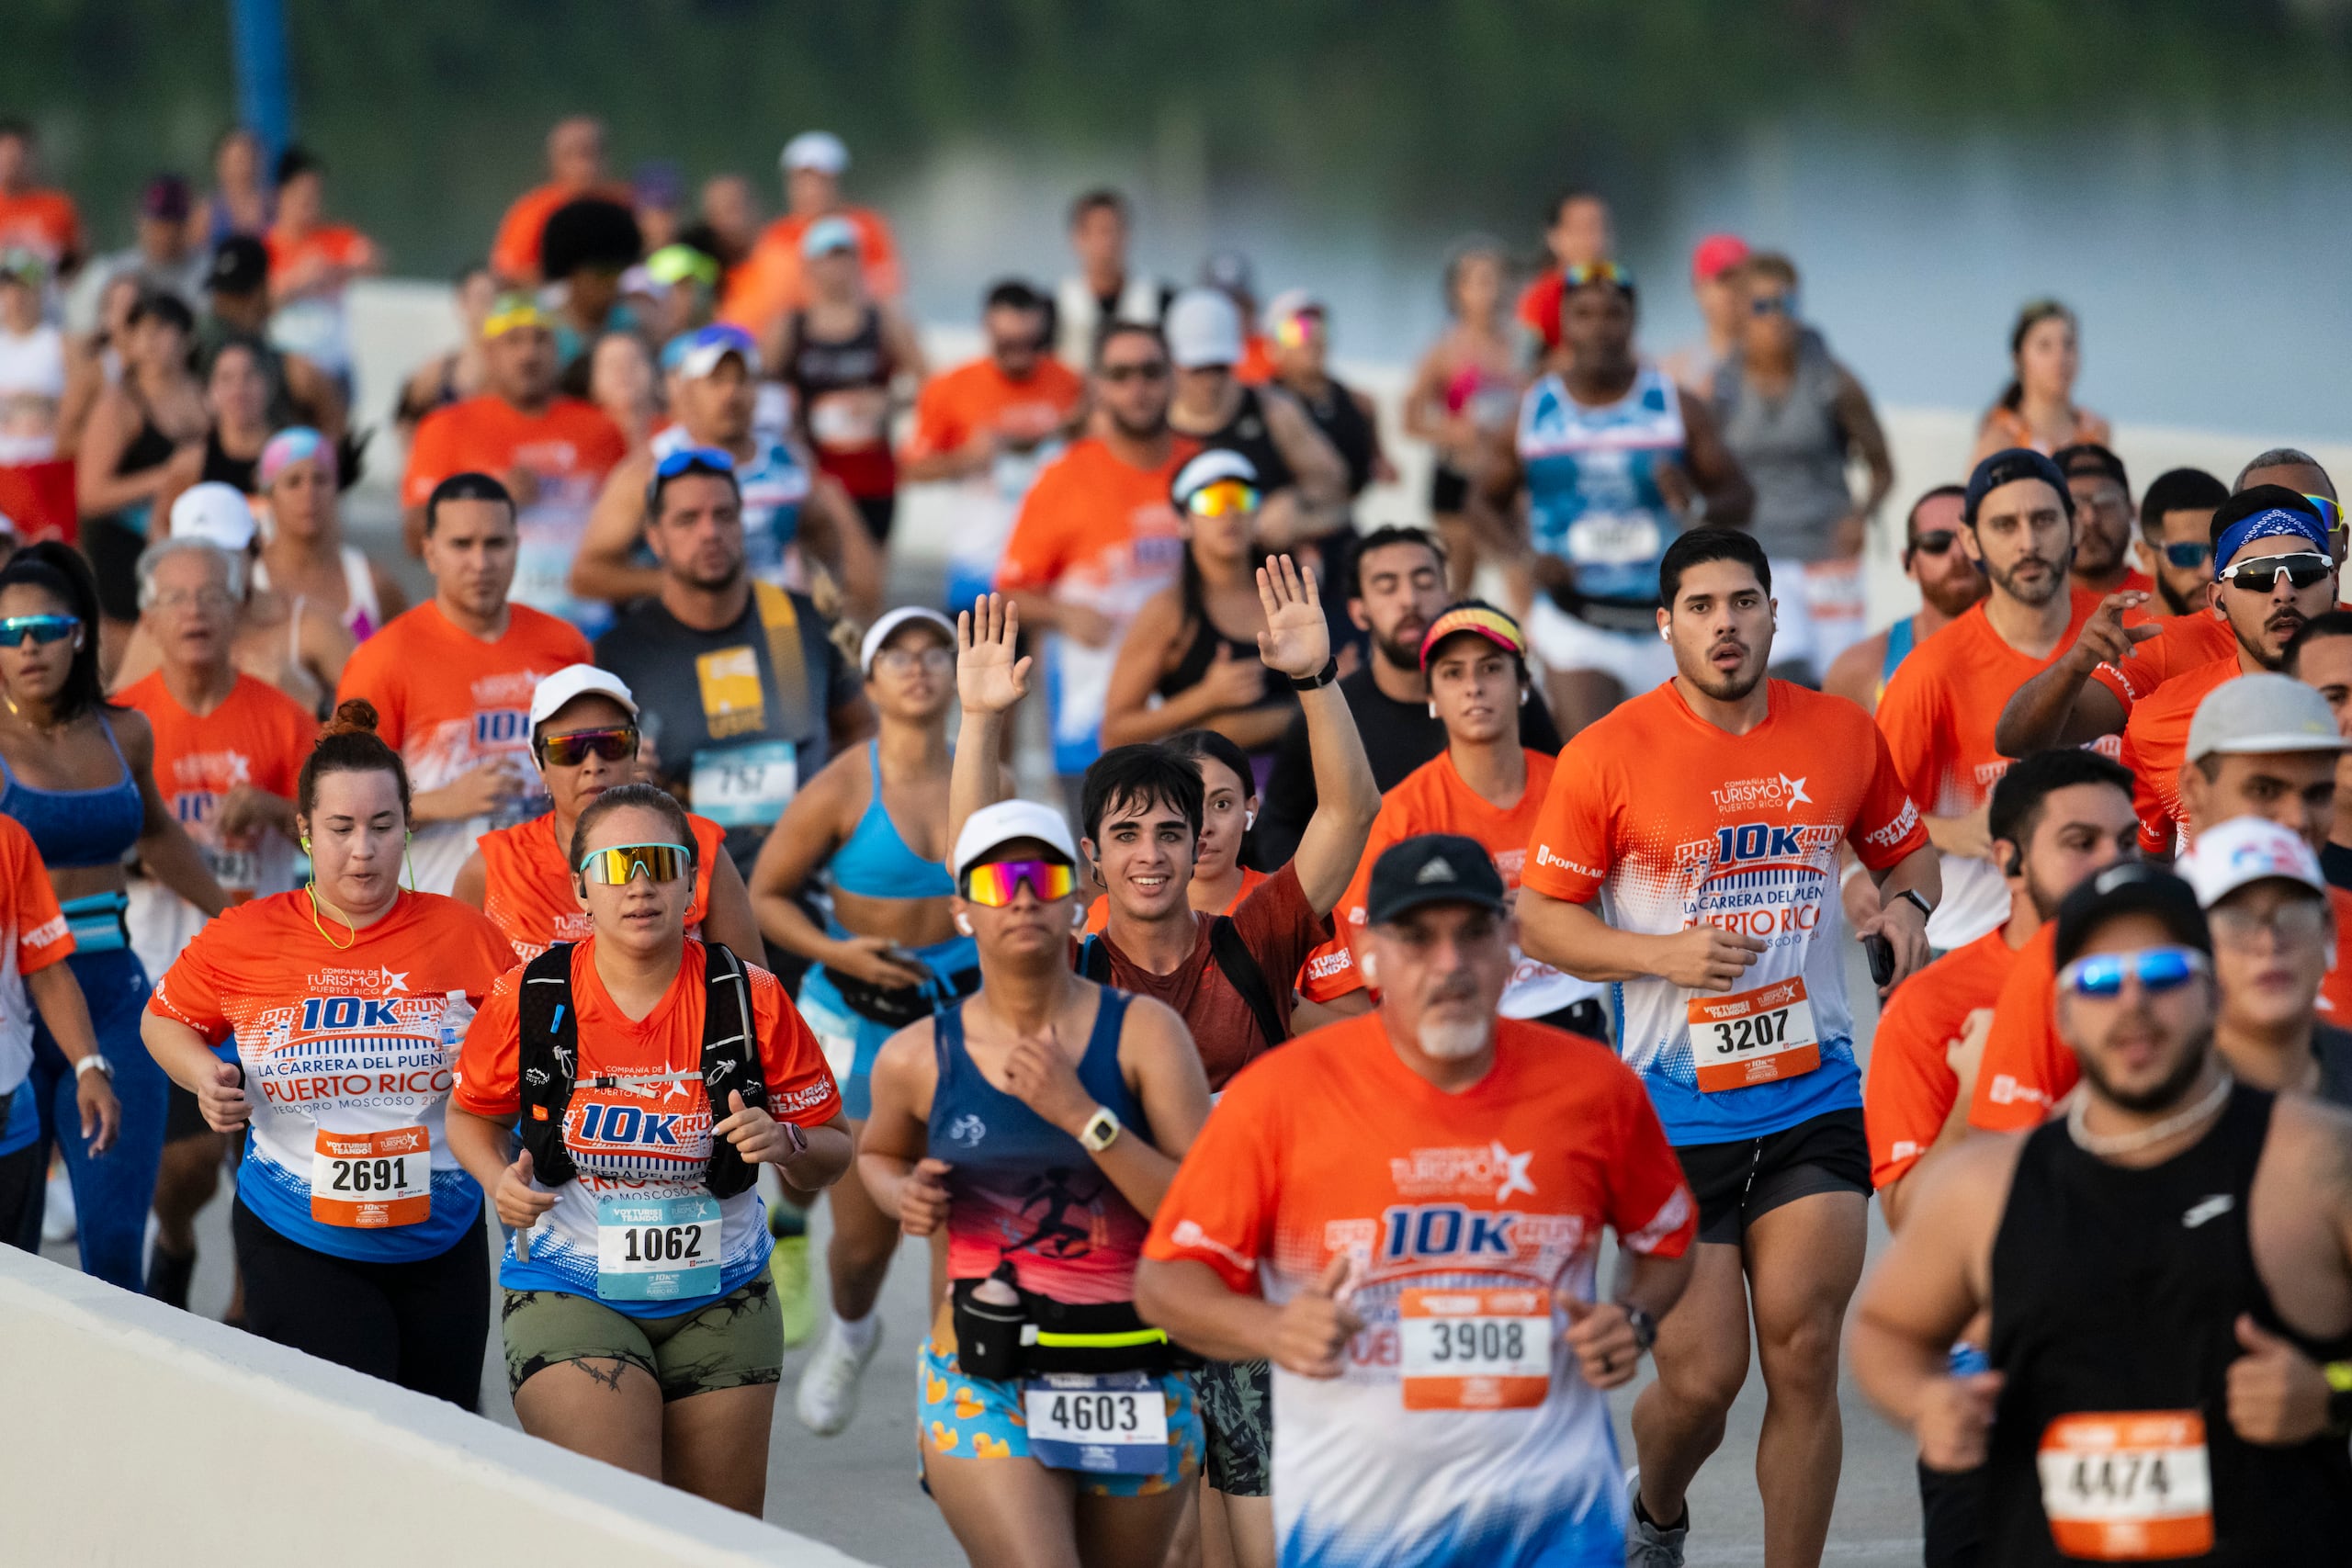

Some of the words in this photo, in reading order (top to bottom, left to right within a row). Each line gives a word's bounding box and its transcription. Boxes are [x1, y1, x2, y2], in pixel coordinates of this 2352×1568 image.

[1711, 784, 1781, 806] TURISMO
[1718, 802, 1756, 814] PUERTO
[1758, 798, 1784, 808] RICO
[1676, 840, 1710, 863] PR
[1717, 822, 1807, 864] 10K
[1547, 853, 1603, 878] POPULAR
[1684, 901, 1697, 914] LA
[1700, 893, 1763, 909] CARRERA
[1768, 891, 1791, 904] DEL
[1793, 886, 1825, 900] PUEN
[553, 916, 594, 931] TURIS
[306, 973, 379, 987] TURISMO
[311, 986, 349, 994] PUERTO
[262, 1008, 295, 1025] PR
[301, 997, 401, 1031] 10K
[400, 998, 447, 1014] RUN
[1713, 1008, 1789, 1054] 3207
[258, 1065, 274, 1077] LA
[277, 1058, 358, 1075] CARRERA
[363, 1056, 393, 1069] DEL
[651, 1066, 662, 1074] DE
[262, 1074, 372, 1102] PUERTO
[379, 1069, 454, 1093] RICO
[594, 1088, 633, 1097] PUERTO
[273, 1101, 333, 1115] TEODORO
[339, 1096, 414, 1109] MOSCOSO
[580, 1102, 684, 1145] 10K
[681, 1114, 713, 1134] RU
[332, 1157, 408, 1191] 2691
[620, 1186, 690, 1201] MOSCOSO
[625, 1224, 702, 1261] 1062
[1383, 1203, 1517, 1258] 10K
[1431, 1322, 1524, 1361] 3908
[1051, 1395, 1137, 1431] 4603
